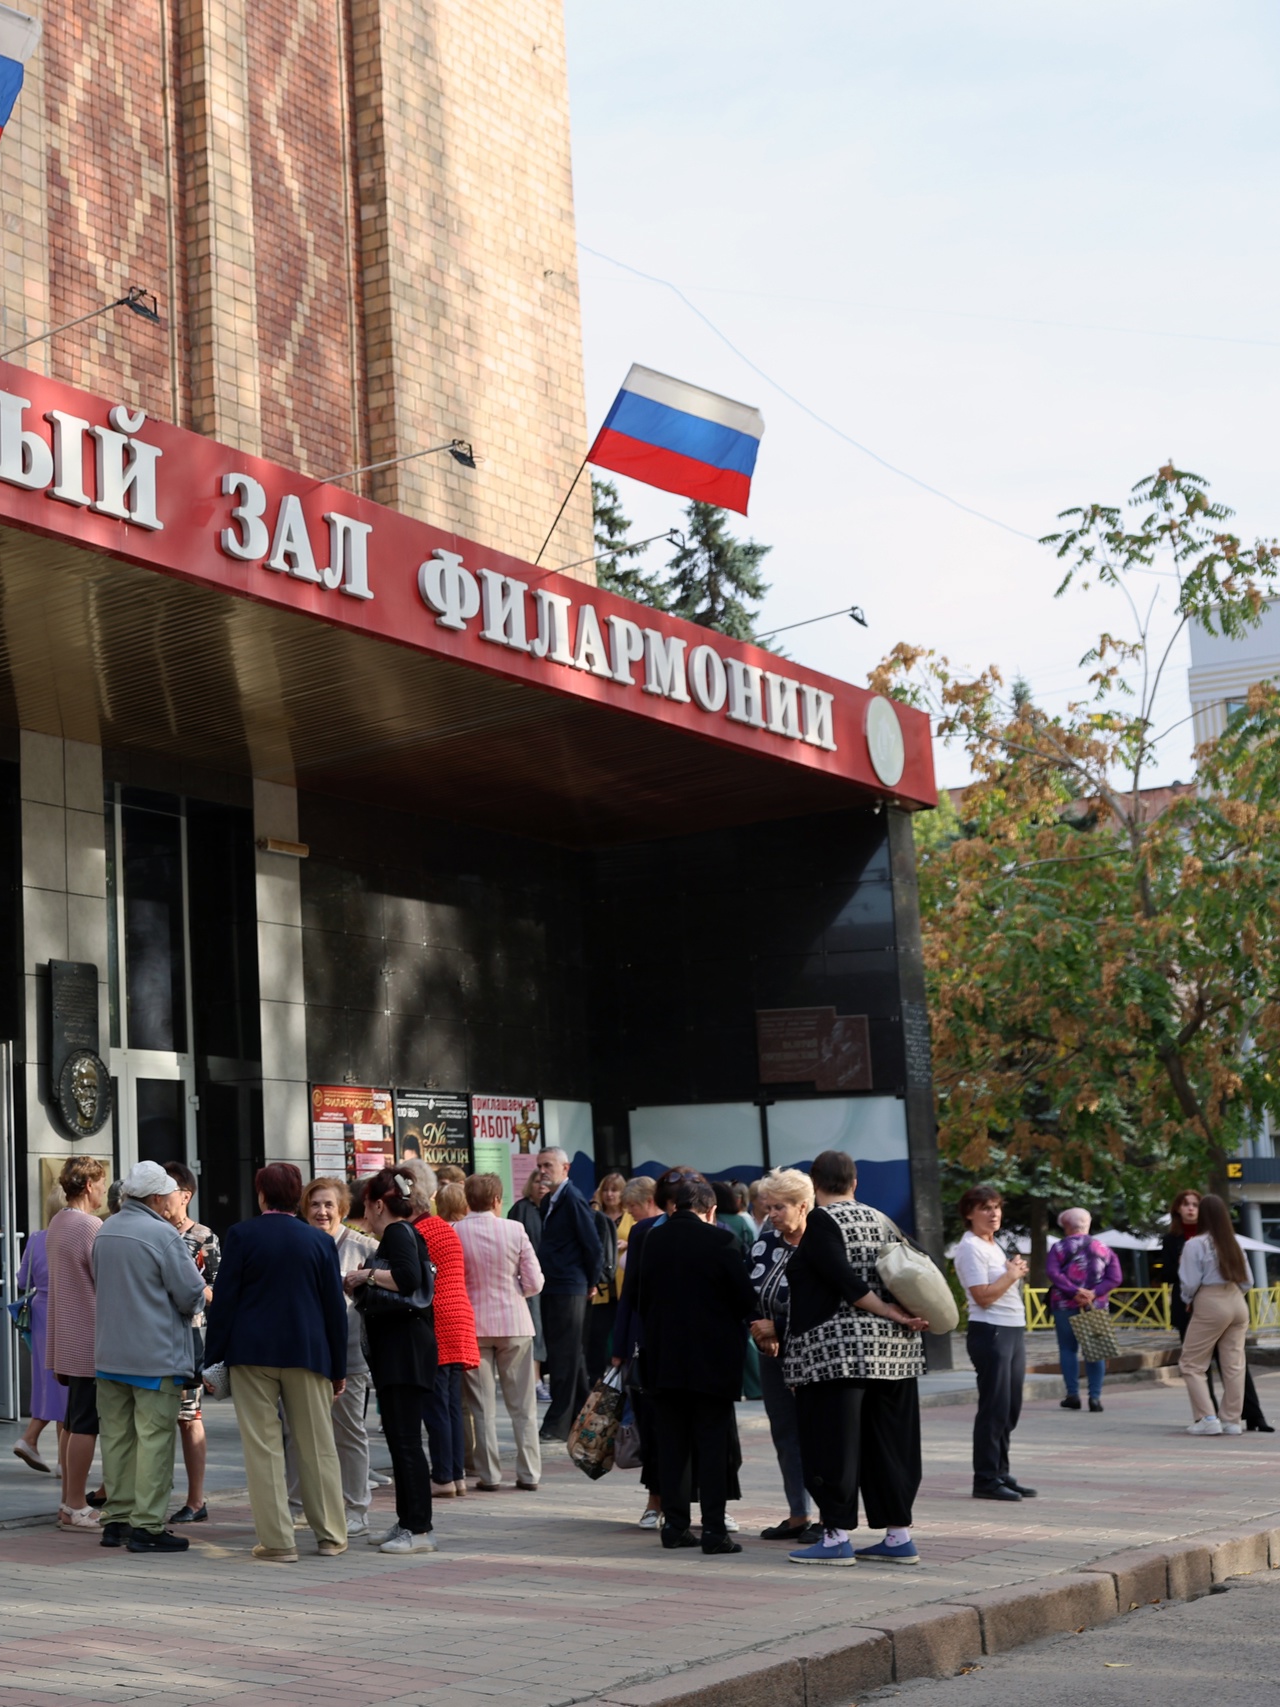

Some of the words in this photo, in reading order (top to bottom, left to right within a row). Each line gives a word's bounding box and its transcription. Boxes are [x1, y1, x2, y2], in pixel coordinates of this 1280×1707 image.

[219, 472, 375, 601] ЗАЛ
[417, 547, 838, 753] ФИЛАРМОНИИ
[471, 1097, 523, 1113] приглашаем
[471, 1115, 517, 1143] РАБОТУ
[423, 1146, 470, 1168] КОРОЛЯ
